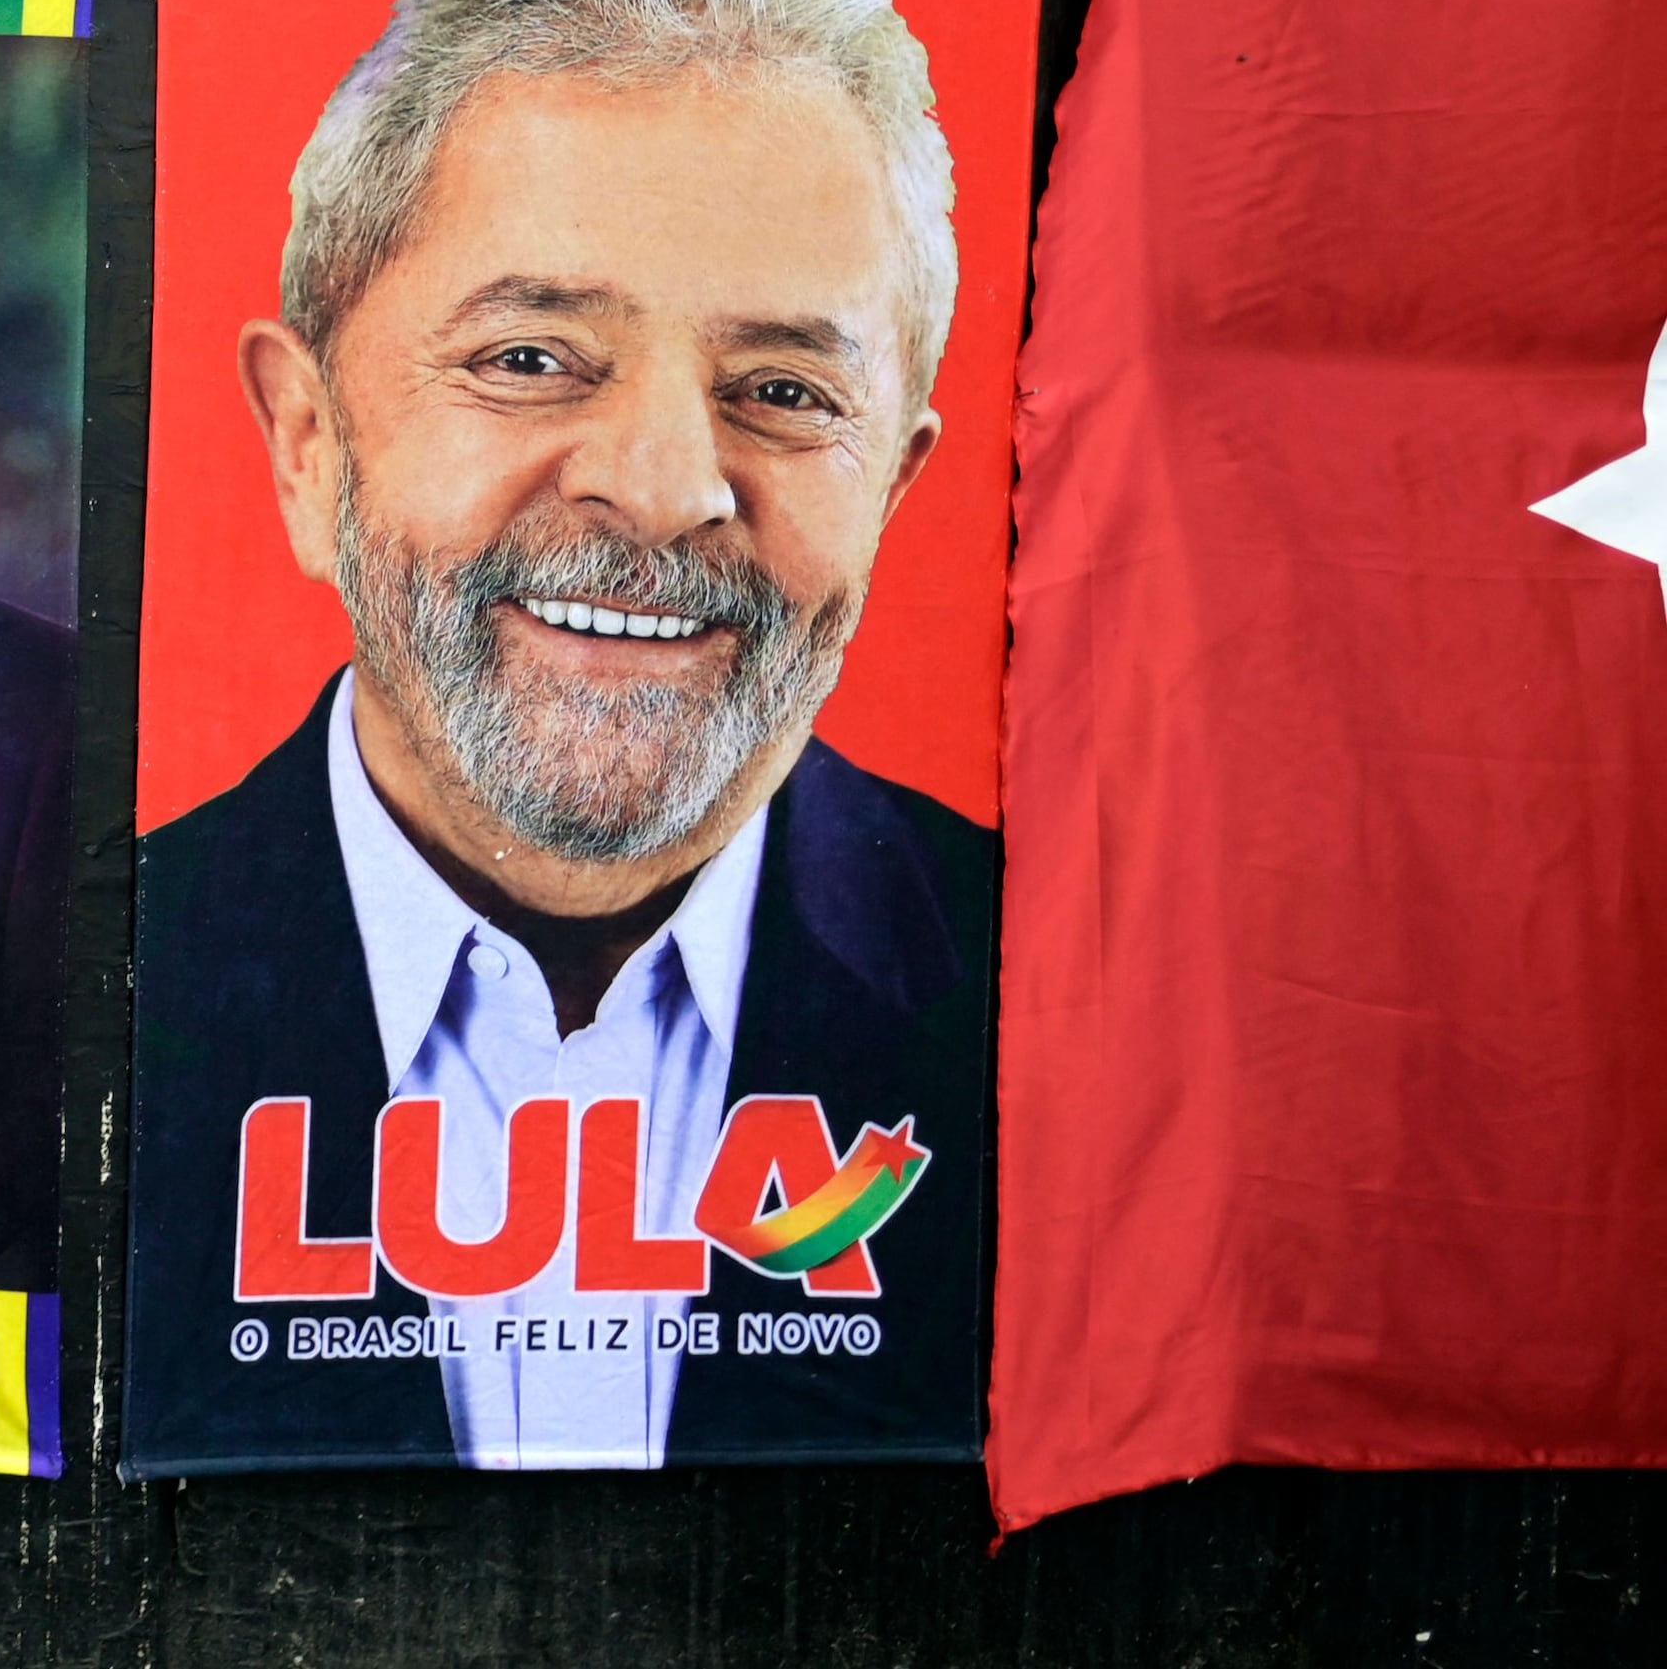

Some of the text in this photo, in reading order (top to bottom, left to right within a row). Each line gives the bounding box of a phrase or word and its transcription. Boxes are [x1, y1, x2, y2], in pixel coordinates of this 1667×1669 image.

[234, 1094, 881, 1300] LULA
[233, 1315, 879, 1359] O BRASIL FELIZ DE NOVO
